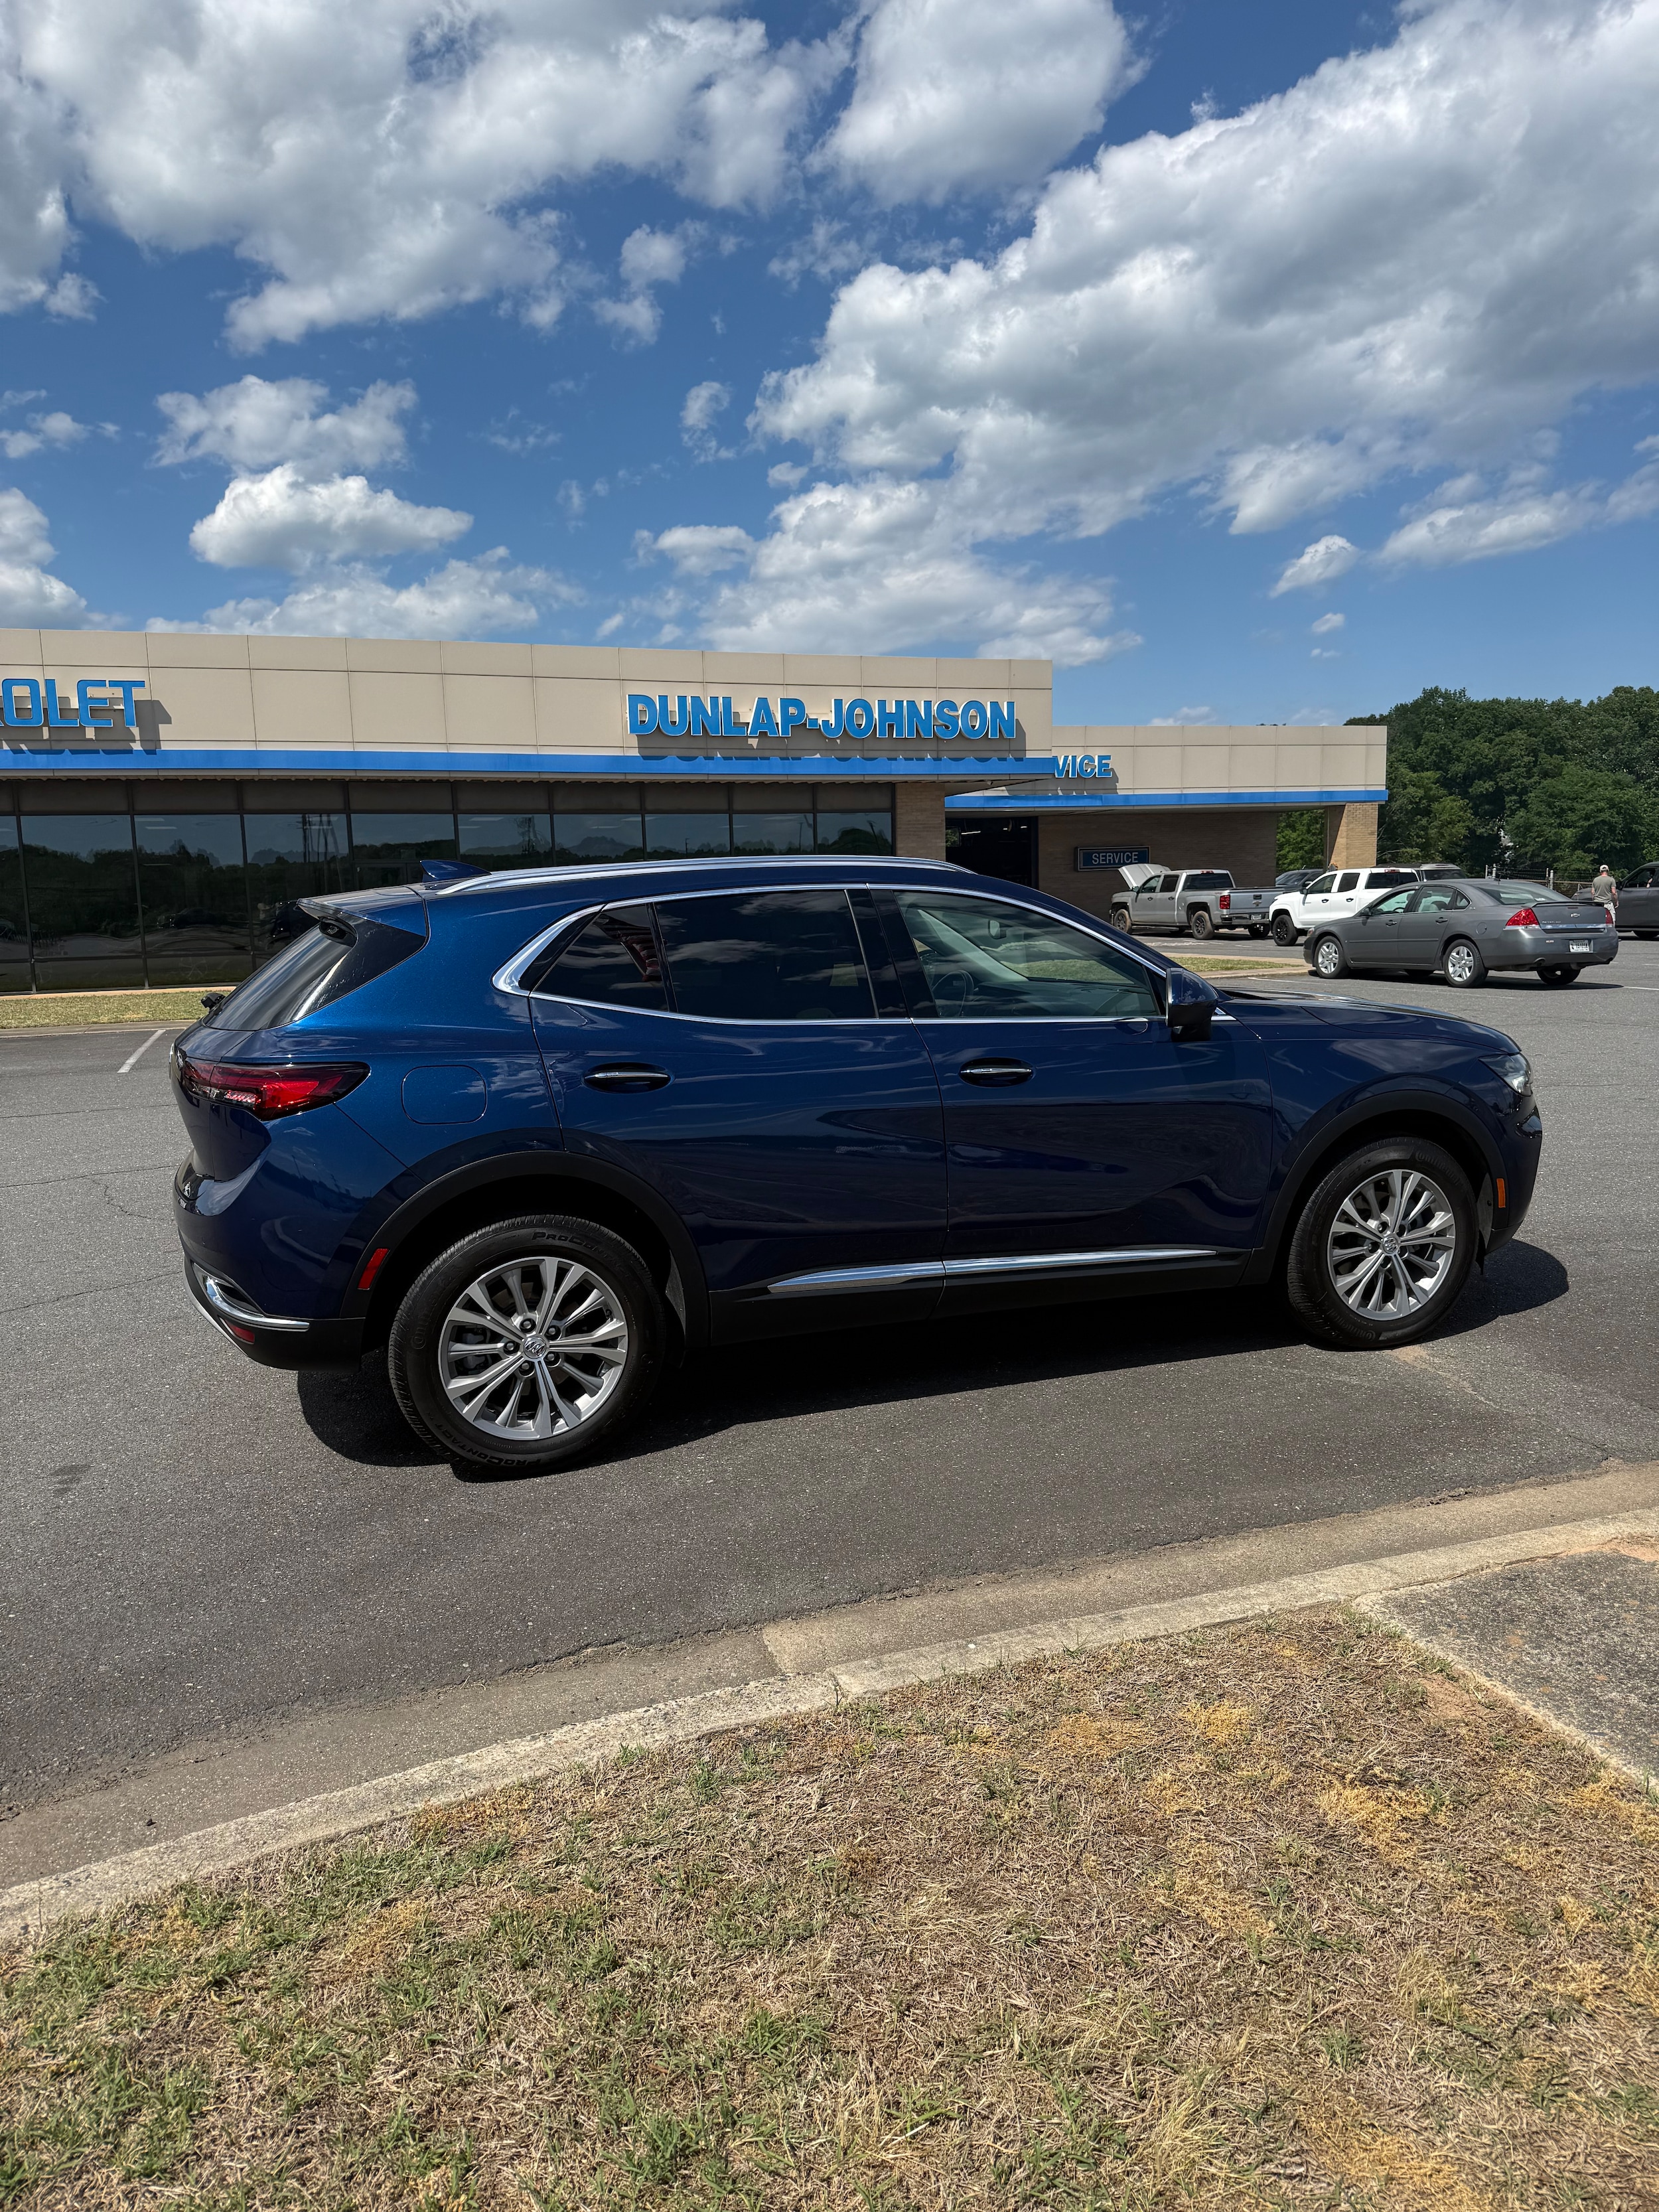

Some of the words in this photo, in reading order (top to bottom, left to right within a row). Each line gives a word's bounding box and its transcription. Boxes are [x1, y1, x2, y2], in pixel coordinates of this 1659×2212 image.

[0, 678, 145, 727] OLET
[626, 694, 1016, 739] DUNLAP-JOHNSON
[1092, 851, 1139, 865] SERVICE
